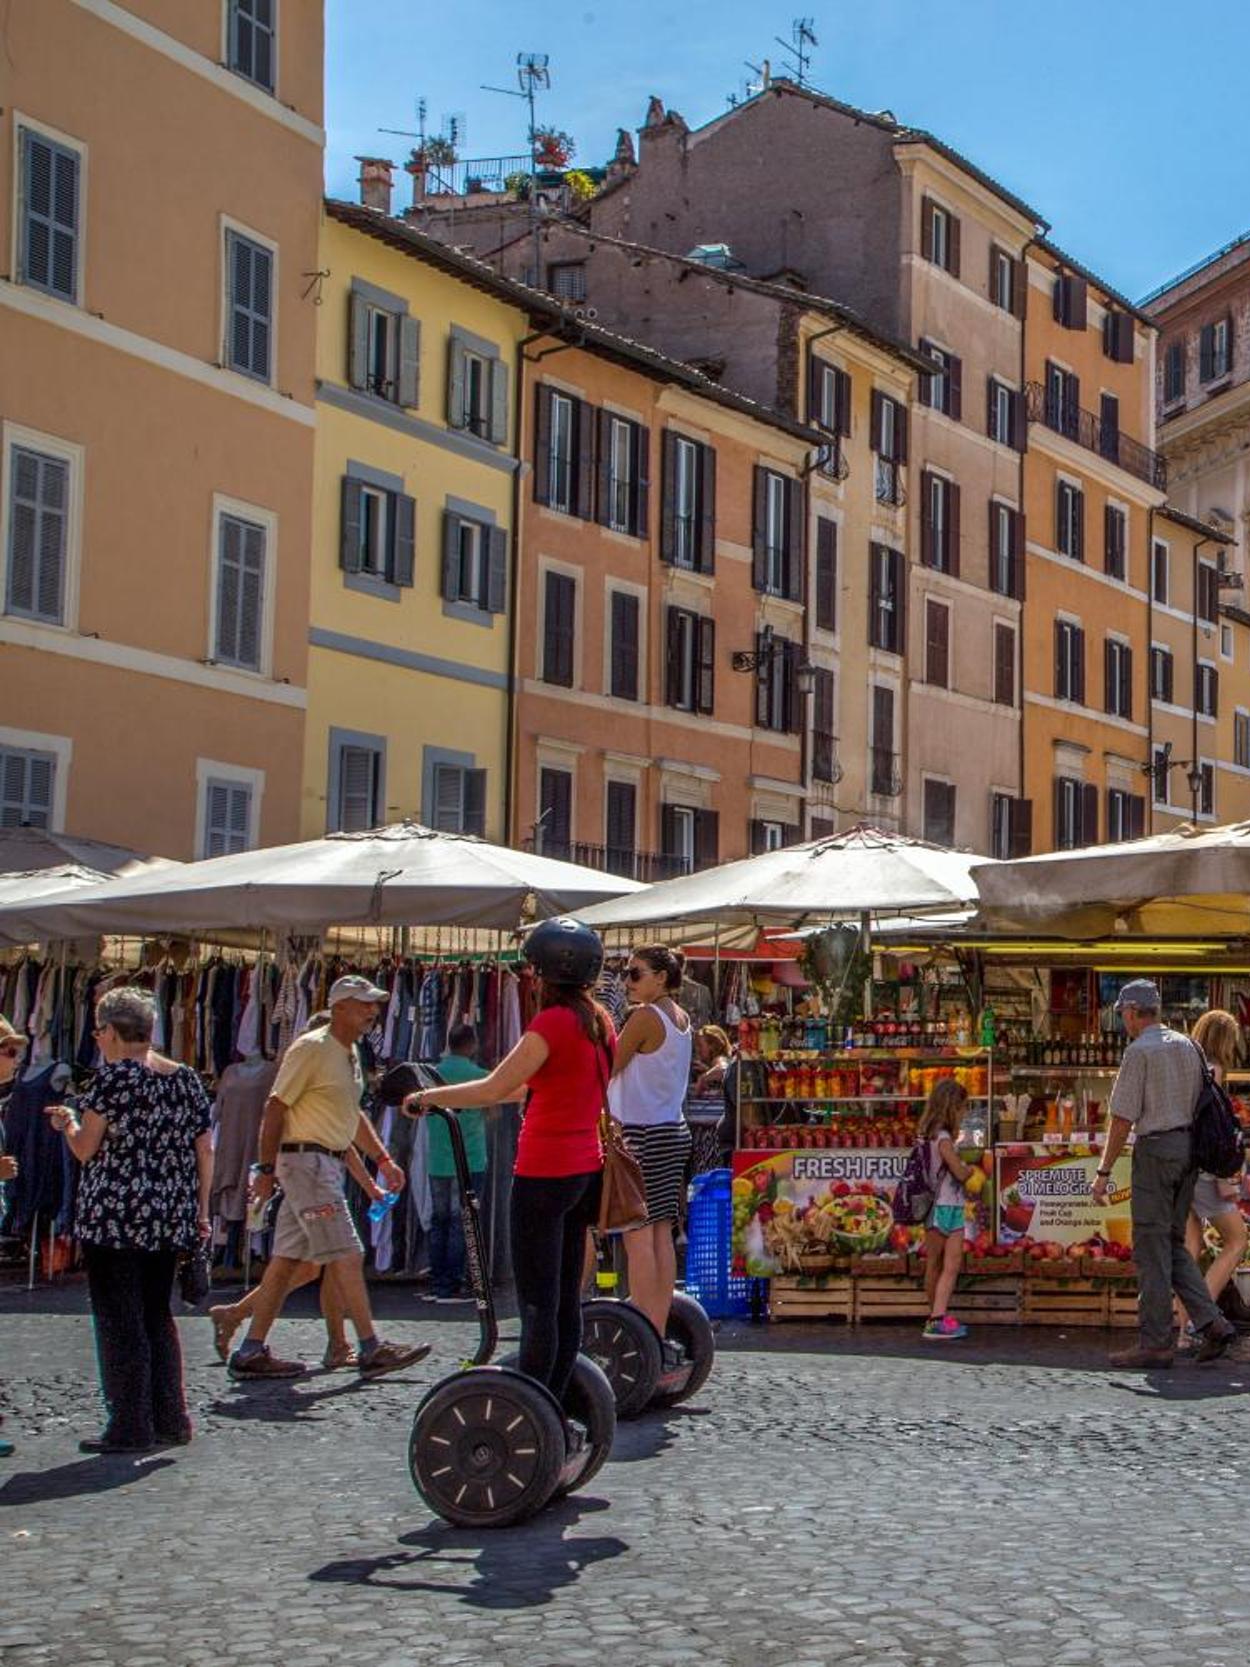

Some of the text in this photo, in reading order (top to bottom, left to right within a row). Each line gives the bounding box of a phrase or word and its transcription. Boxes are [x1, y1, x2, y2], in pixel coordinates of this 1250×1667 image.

[793, 1157, 908, 1179] FRESH FRU
[1018, 1168, 1086, 1181] SPREMUTE
[1018, 1181, 1117, 1195] DI MELOGRAO
[1040, 1218, 1054, 1226] and
[1055, 1219, 1082, 1229] Orange
